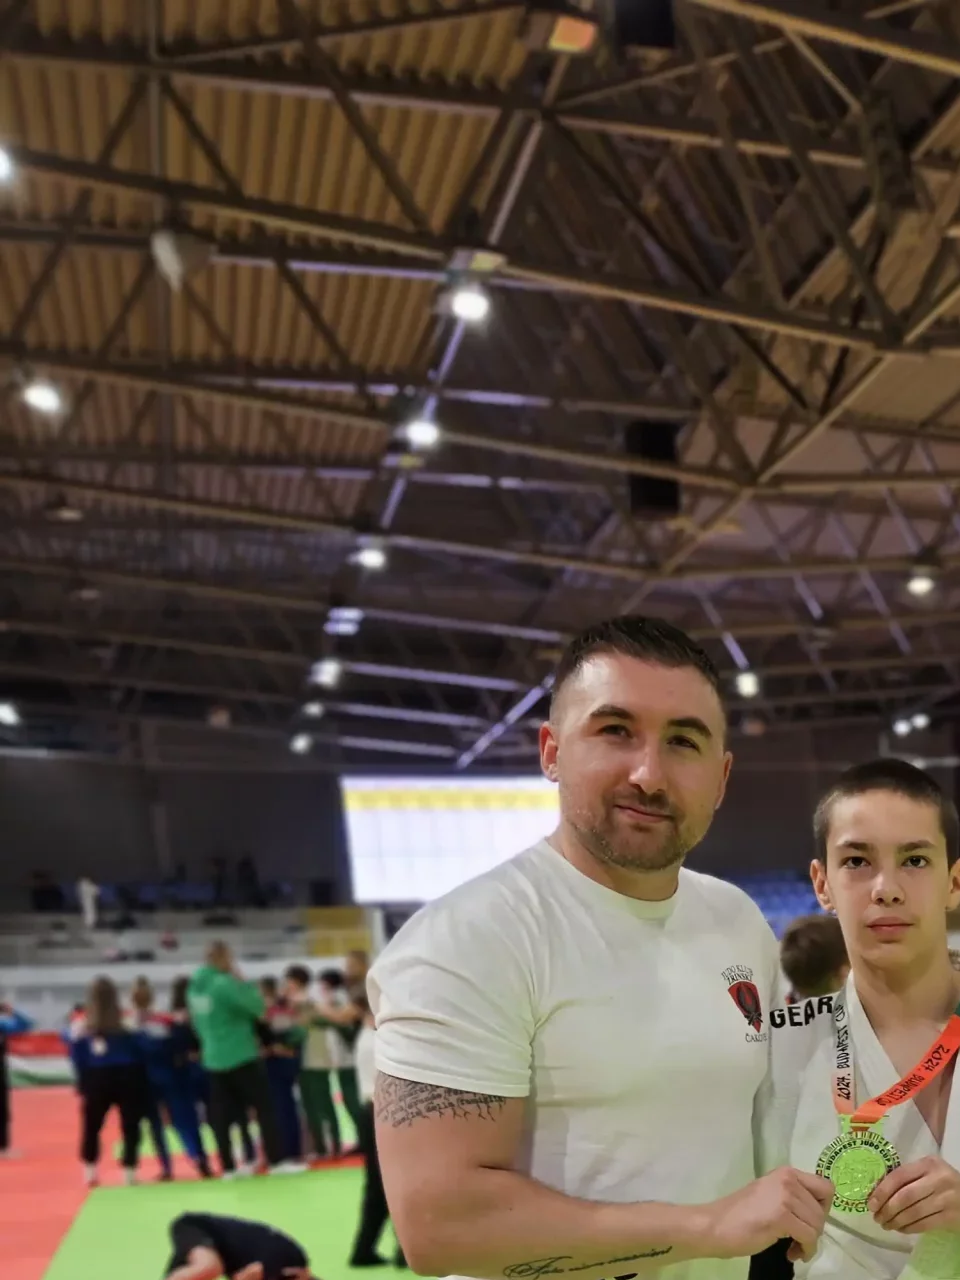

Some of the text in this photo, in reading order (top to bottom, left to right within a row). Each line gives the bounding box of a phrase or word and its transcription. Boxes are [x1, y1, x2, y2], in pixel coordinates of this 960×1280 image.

[769, 996, 833, 1028] GEAR
[836, 1025, 850, 1069] BUDAPEST
[826, 1140, 857, 1170] BUDAPEST
[860, 1140, 879, 1151] JUDO
[879, 1149, 891, 1164] CUP
